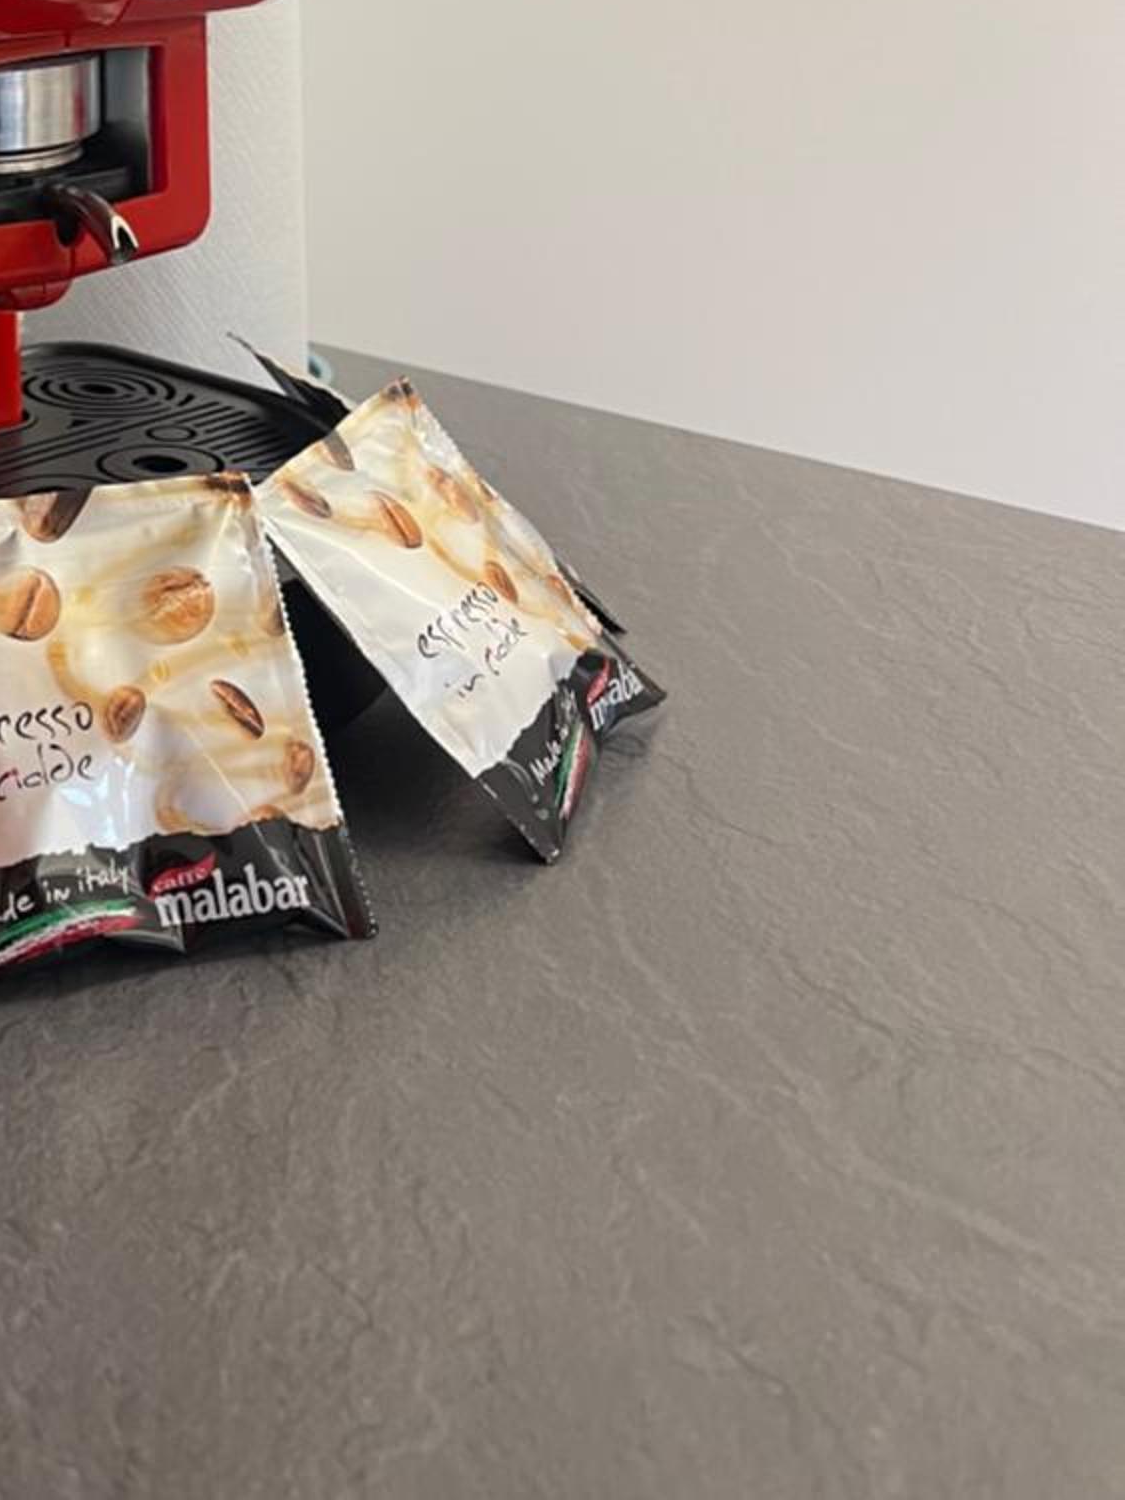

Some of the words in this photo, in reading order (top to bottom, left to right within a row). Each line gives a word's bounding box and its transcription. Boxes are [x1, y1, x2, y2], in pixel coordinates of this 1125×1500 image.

[41, 880, 72, 904] in
[75, 857, 131, 895] italy
[154, 863, 311, 929] malabar
